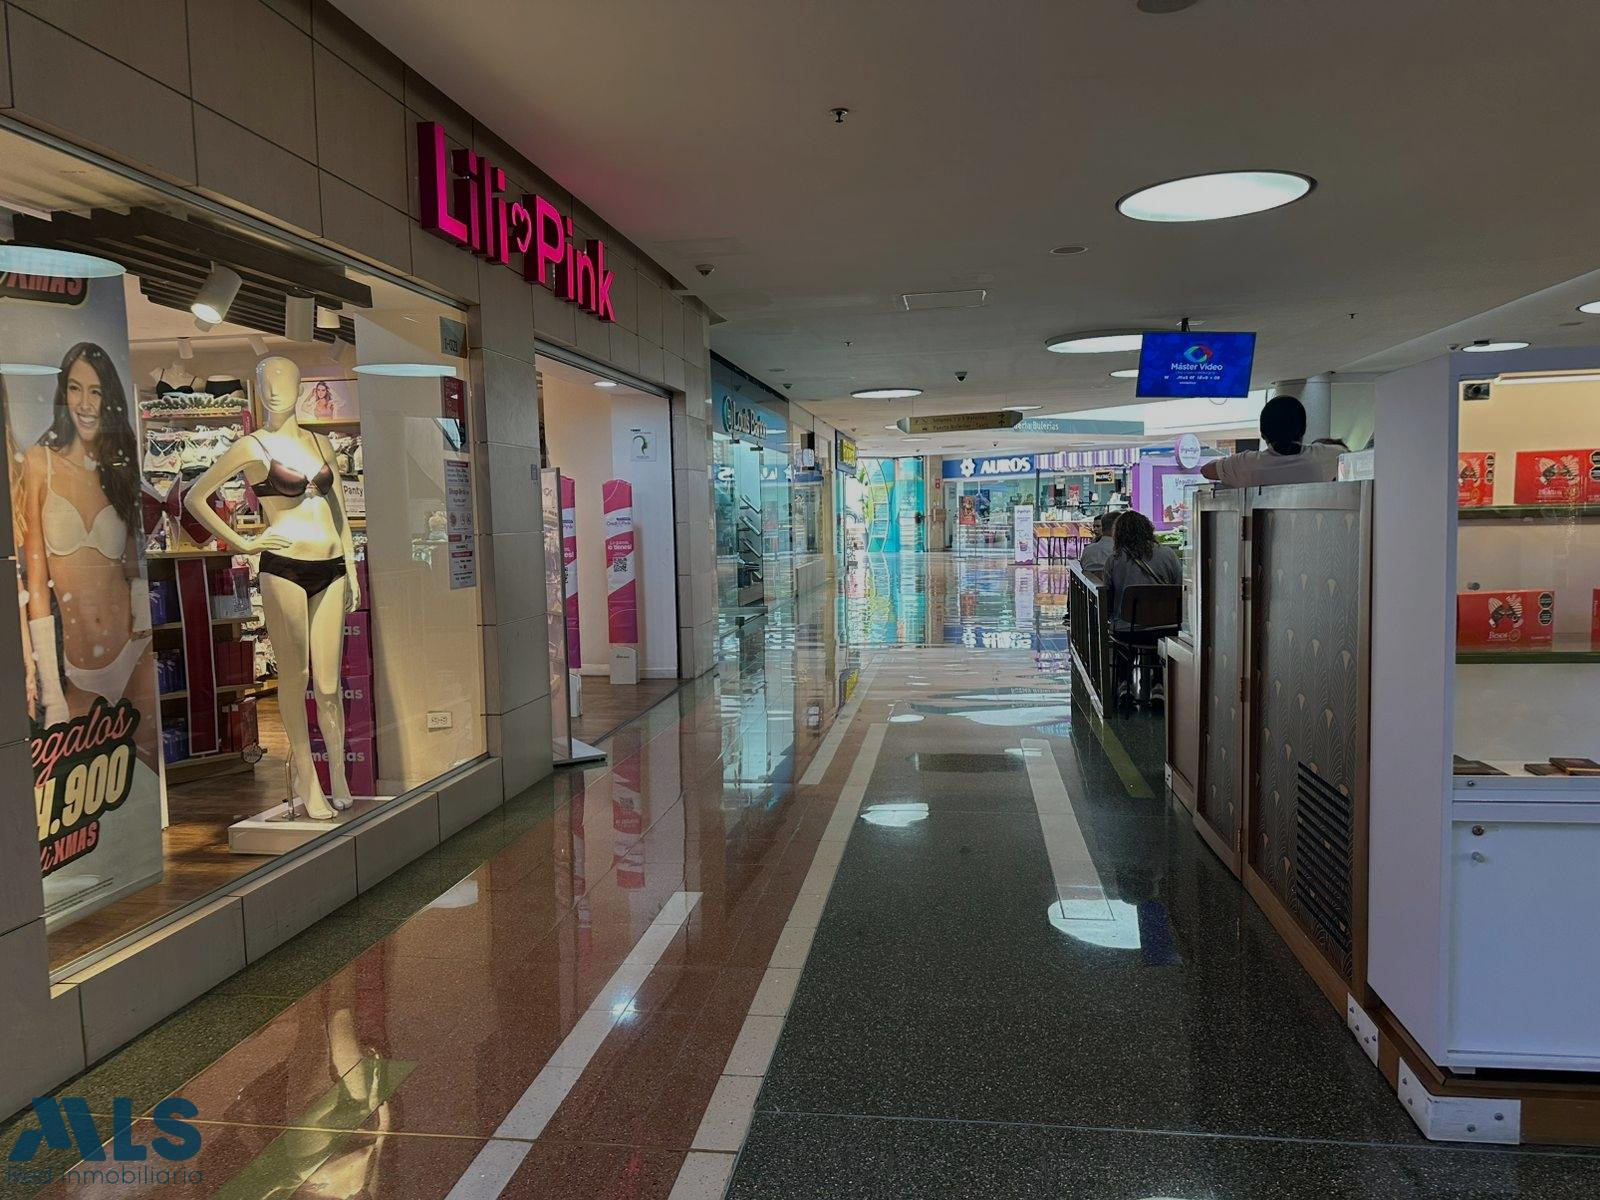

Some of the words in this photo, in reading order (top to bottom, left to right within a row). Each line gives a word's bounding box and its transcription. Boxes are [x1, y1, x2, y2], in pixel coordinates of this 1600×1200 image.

[417, 122, 509, 265] Lili
[523, 194, 616, 323] Pink
[1199, 363, 1223, 371] Video
[31, 705, 134, 788] egalos
[311, 749, 366, 762] meias
